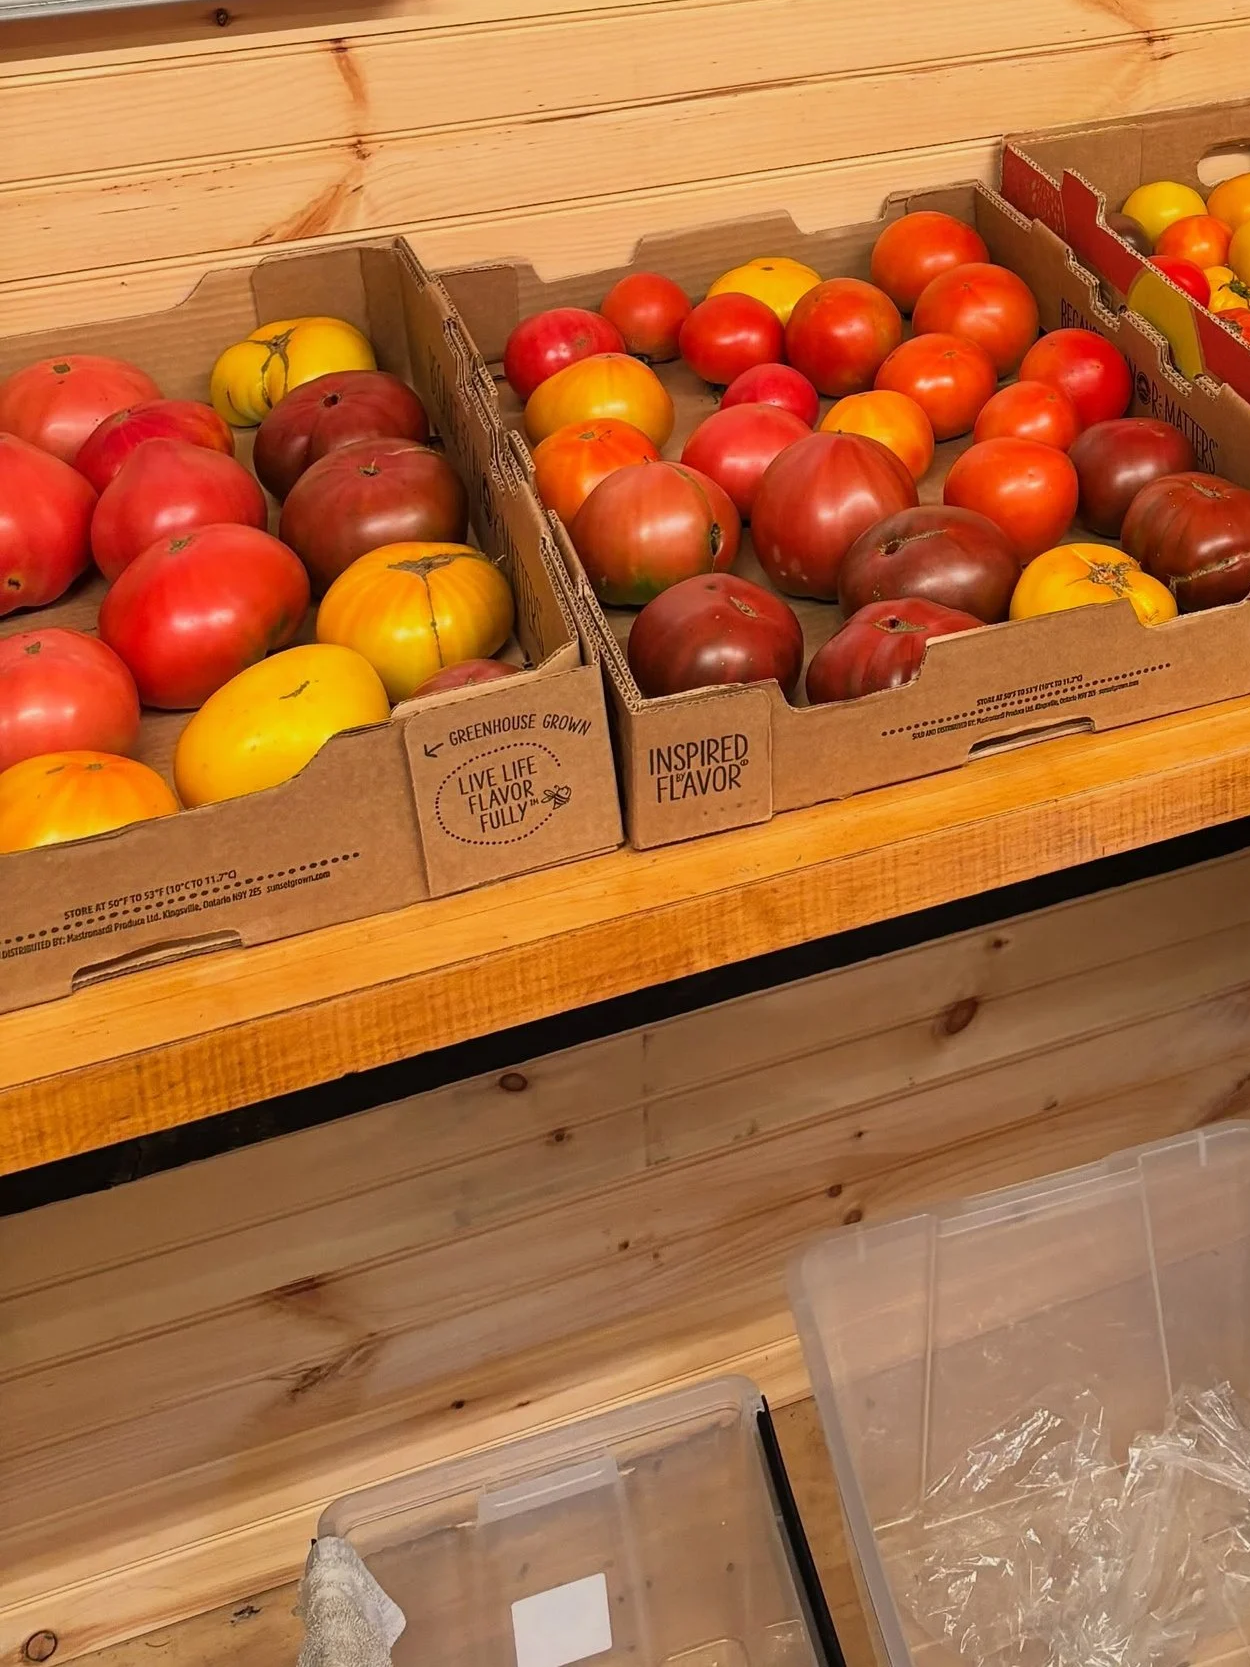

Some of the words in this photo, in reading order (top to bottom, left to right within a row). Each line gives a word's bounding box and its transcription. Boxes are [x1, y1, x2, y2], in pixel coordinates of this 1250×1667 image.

[449, 713, 537, 746] GREENHOUSE
[542, 713, 592, 736] GROWN
[649, 733, 748, 776] INSPIRED
[458, 767, 497, 795] LIVE
[502, 755, 537, 782] LIFE
[468, 779, 534, 814] FLAVOR
[1, 939, 52, 959] DISTRIBUTED
[114, 918, 146, 932] Produce
[203, 895, 231, 909] Ontario
[266, 870, 331, 894] sunsetgrown.com
[64, 905, 94, 920] STORE
[95, 901, 106, 913] AT
[130, 893, 142, 904] TO
[190, 879, 203, 889] TO
